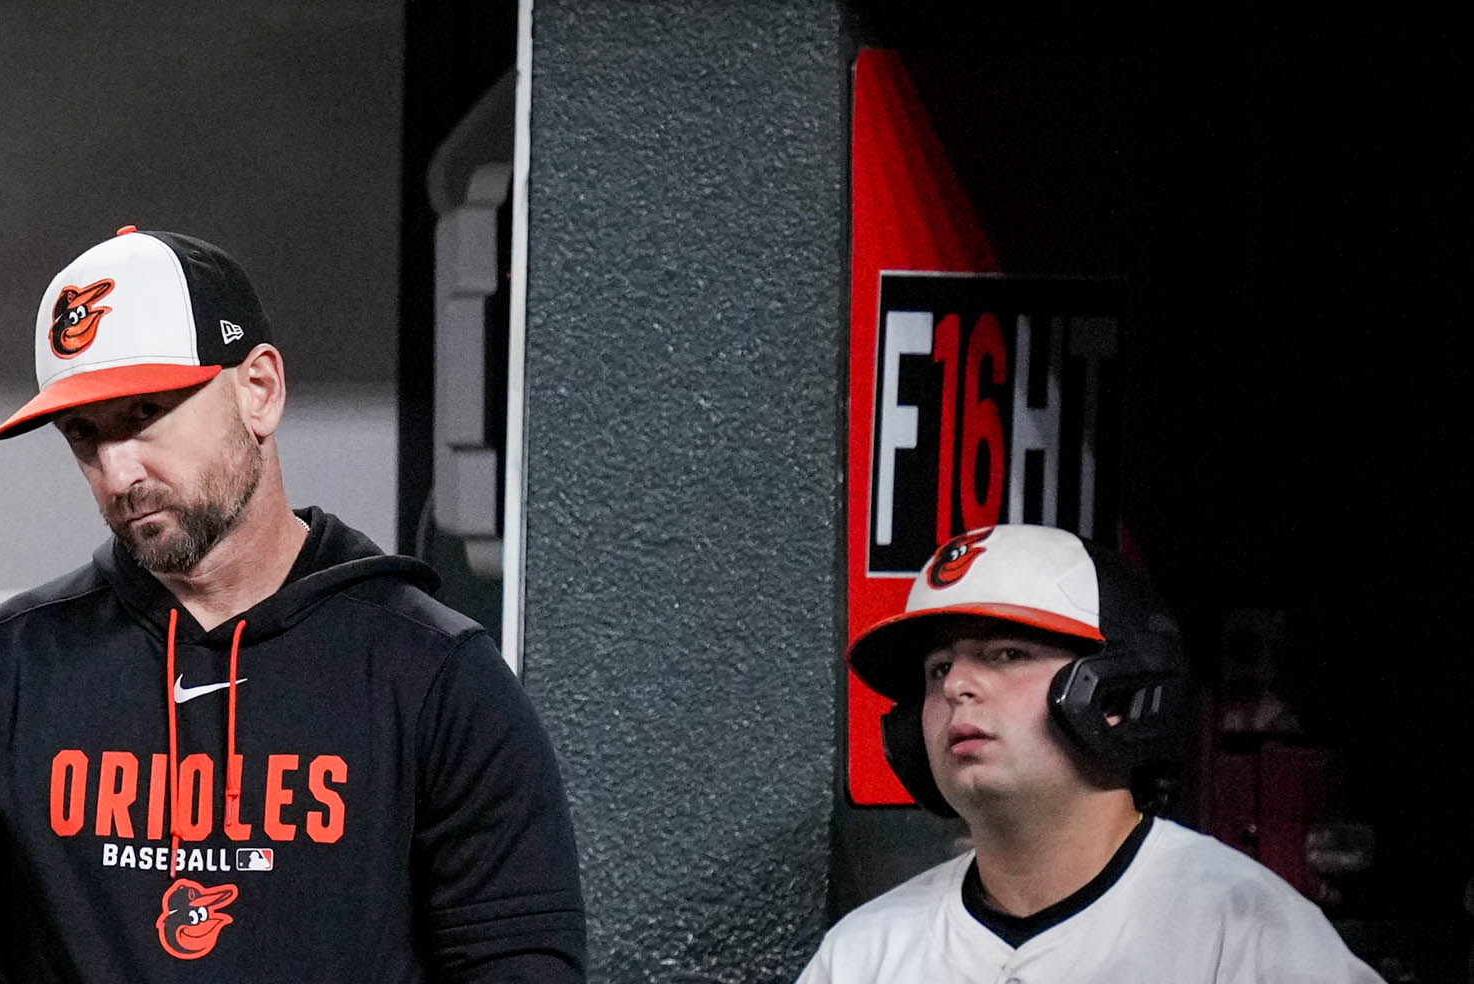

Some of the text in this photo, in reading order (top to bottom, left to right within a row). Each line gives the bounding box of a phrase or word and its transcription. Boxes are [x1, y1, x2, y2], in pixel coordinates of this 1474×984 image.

[876, 311, 1119, 546] F16HT
[49, 749, 348, 844] ORIOLES
[102, 843, 231, 873] BASEBALL
